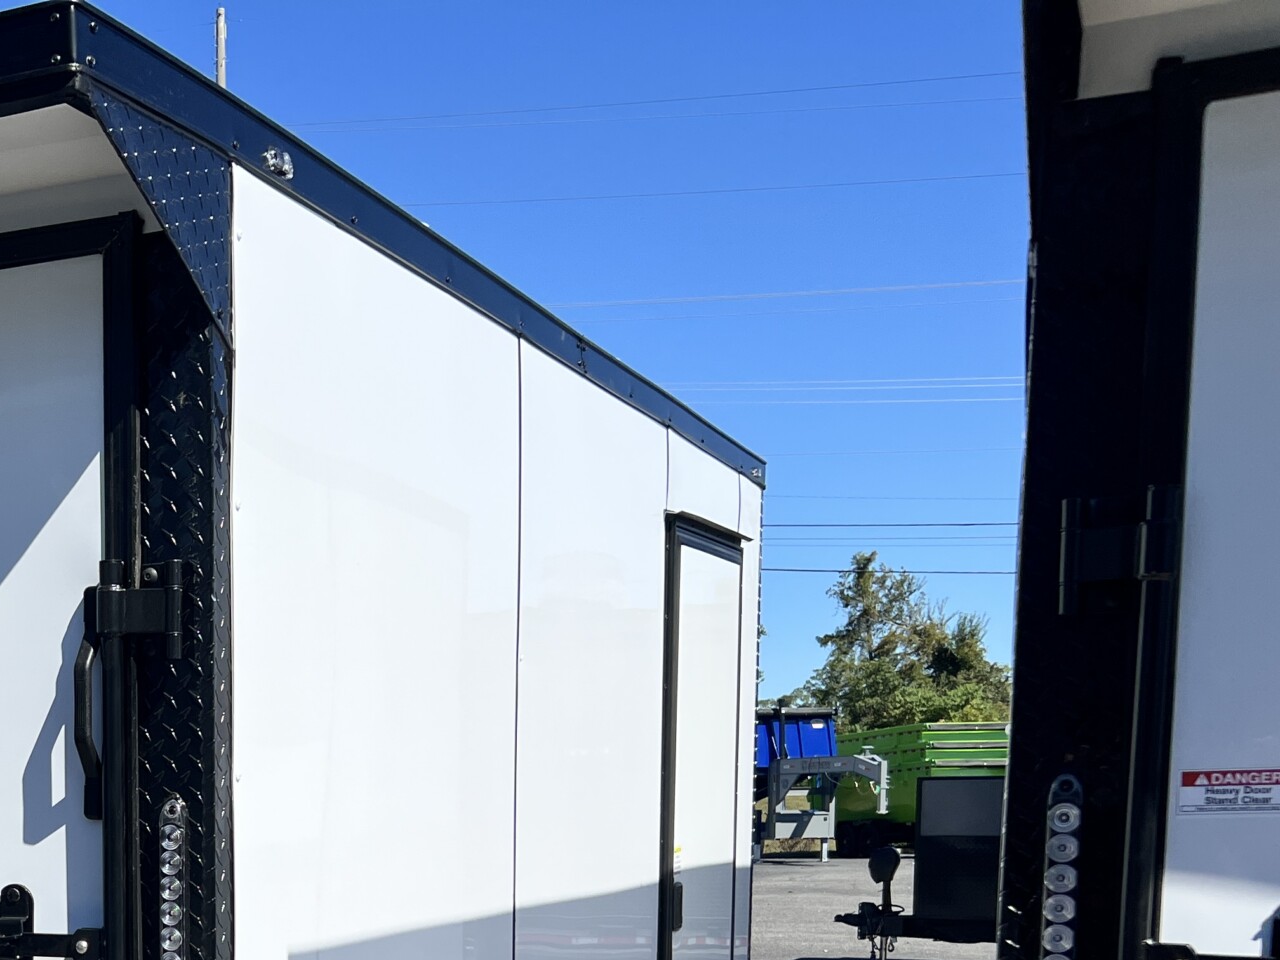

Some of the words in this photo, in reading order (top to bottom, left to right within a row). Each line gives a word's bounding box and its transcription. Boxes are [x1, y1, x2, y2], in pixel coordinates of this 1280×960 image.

[1211, 772, 1280, 784] DANGER
[1205, 786, 1241, 795] Heavy
[1243, 786, 1272, 794] Door
[1205, 796, 1238, 805] Stand
[1241, 796, 1272, 804] Clear
